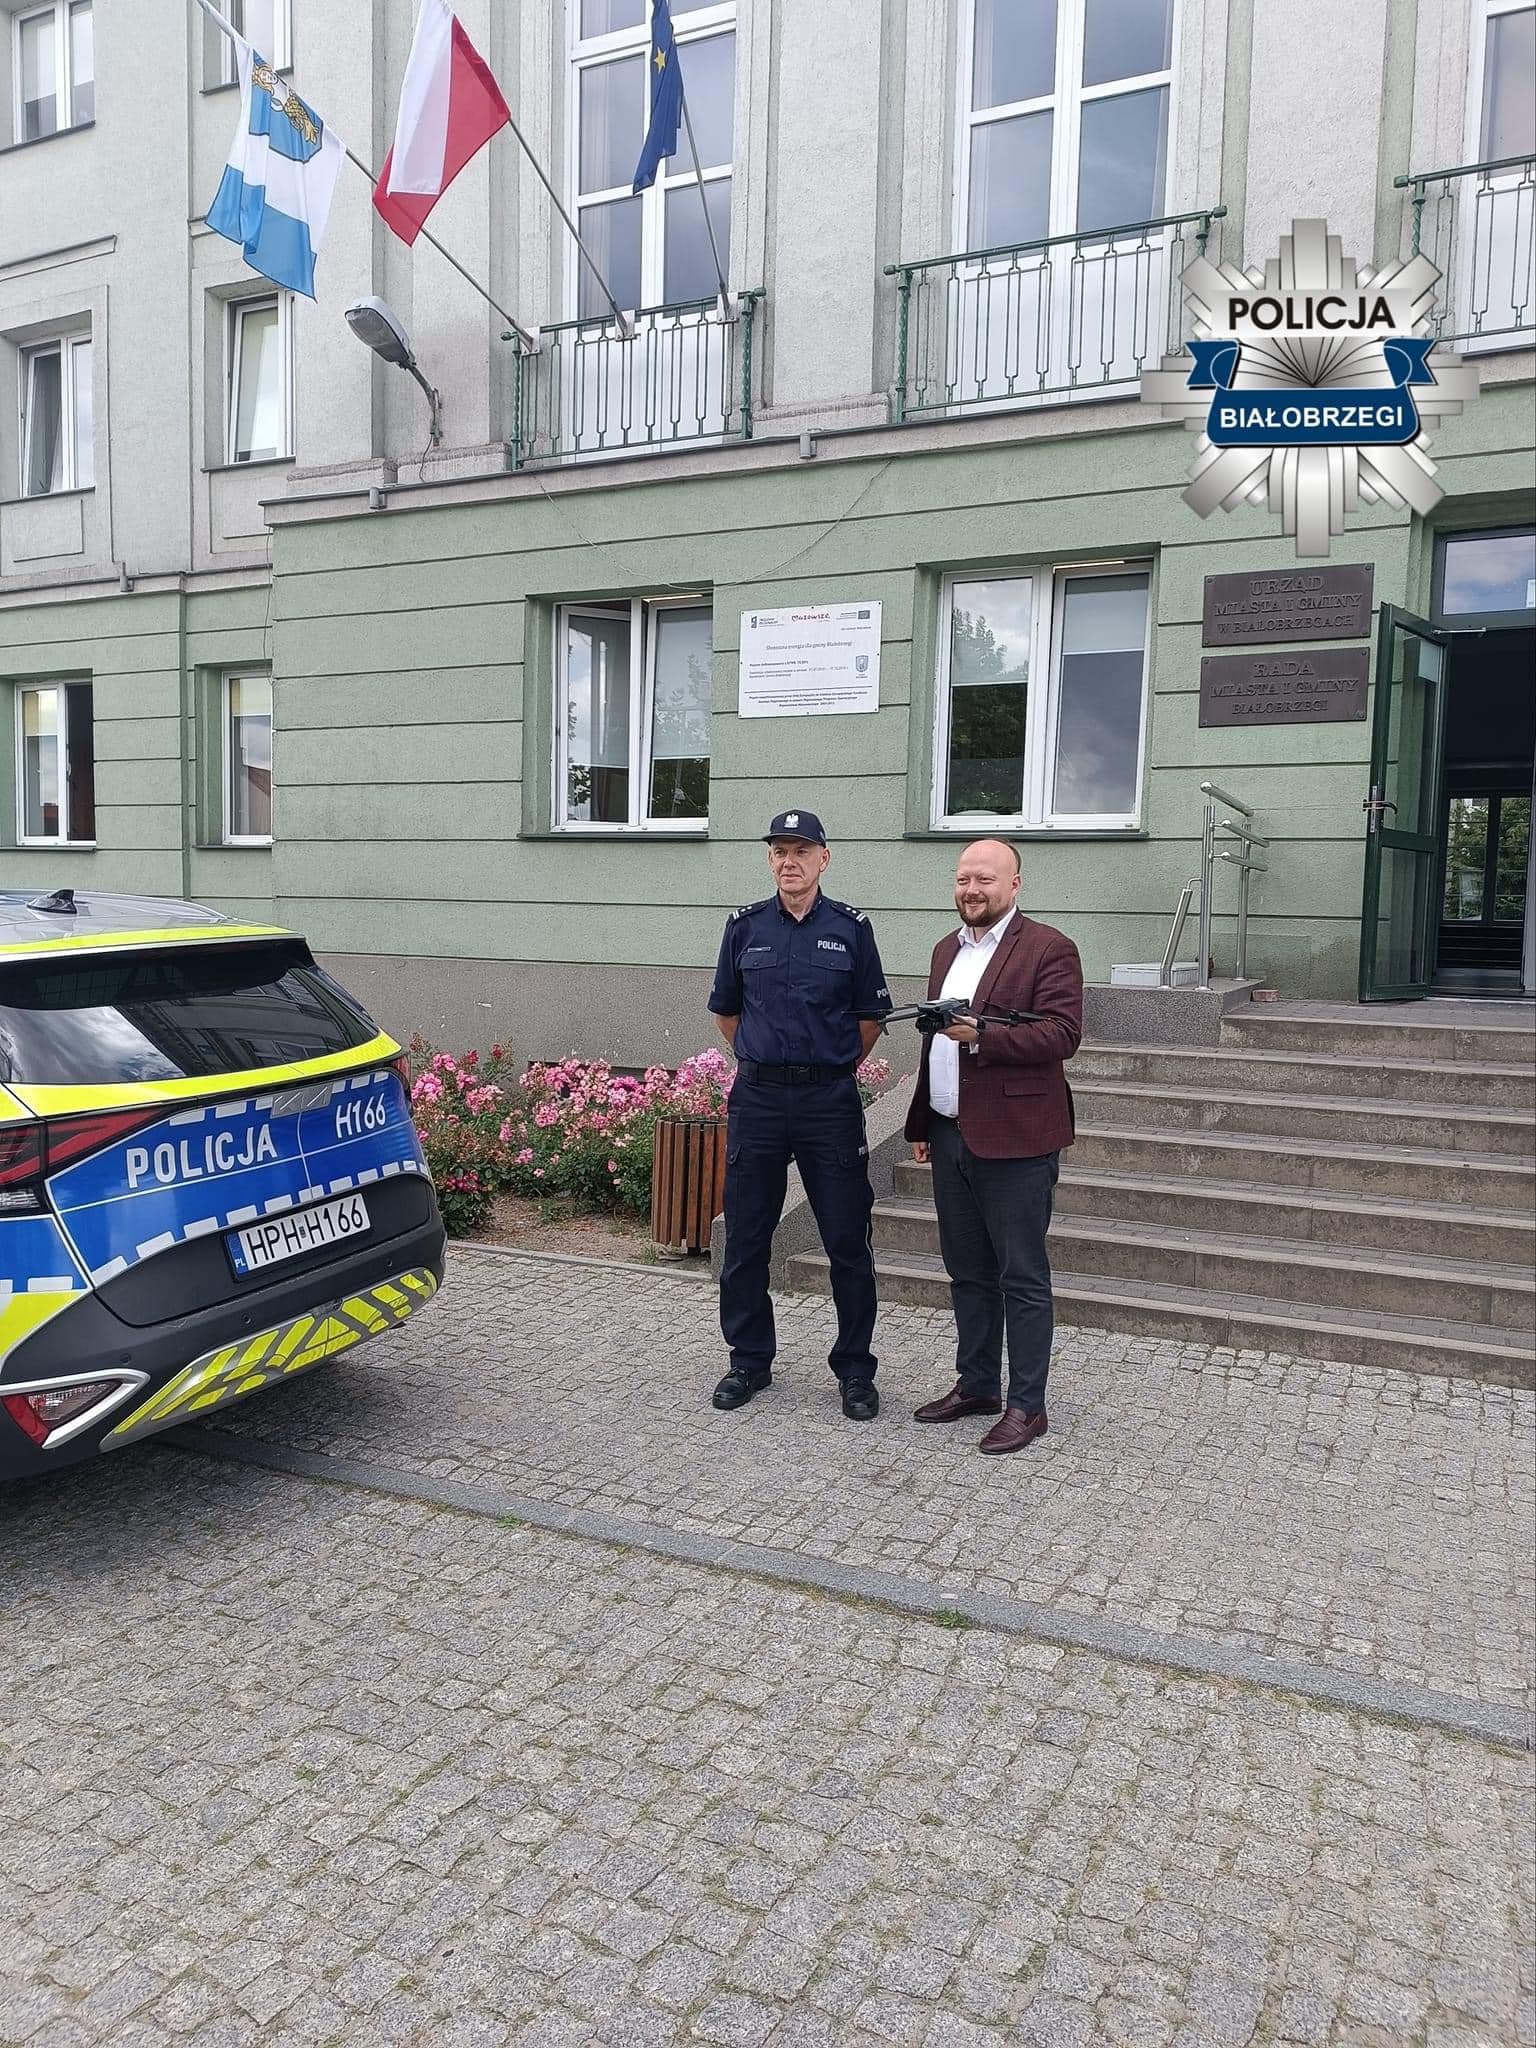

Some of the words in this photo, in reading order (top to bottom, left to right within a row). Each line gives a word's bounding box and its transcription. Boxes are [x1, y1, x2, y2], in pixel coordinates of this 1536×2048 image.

[1250, 576, 1323, 596] URZĄD
[1213, 600, 1283, 617] MIASTA
[1285, 598, 1294, 611] I
[1297, 593, 1362, 610] GMINY
[1217, 623, 1231, 634] W
[1232, 614, 1354, 634] BIAŁOBRZEGACH
[1252, 661, 1315, 678] RADA
[1209, 682, 1279, 698] MIASTA
[1282, 681, 1291, 695] I
[1295, 679, 1360, 694] GMINY
[1230, 700, 1329, 715] BIAŁOBRZEGI
[817, 940, 846, 952] POLICJA
[335, 1093, 387, 1139] H166
[126, 1123, 278, 1188] POLICJA
[246, 1218, 301, 1265] HPH
[304, 1198, 363, 1245] H166
[234, 1258, 246, 1268] PL
